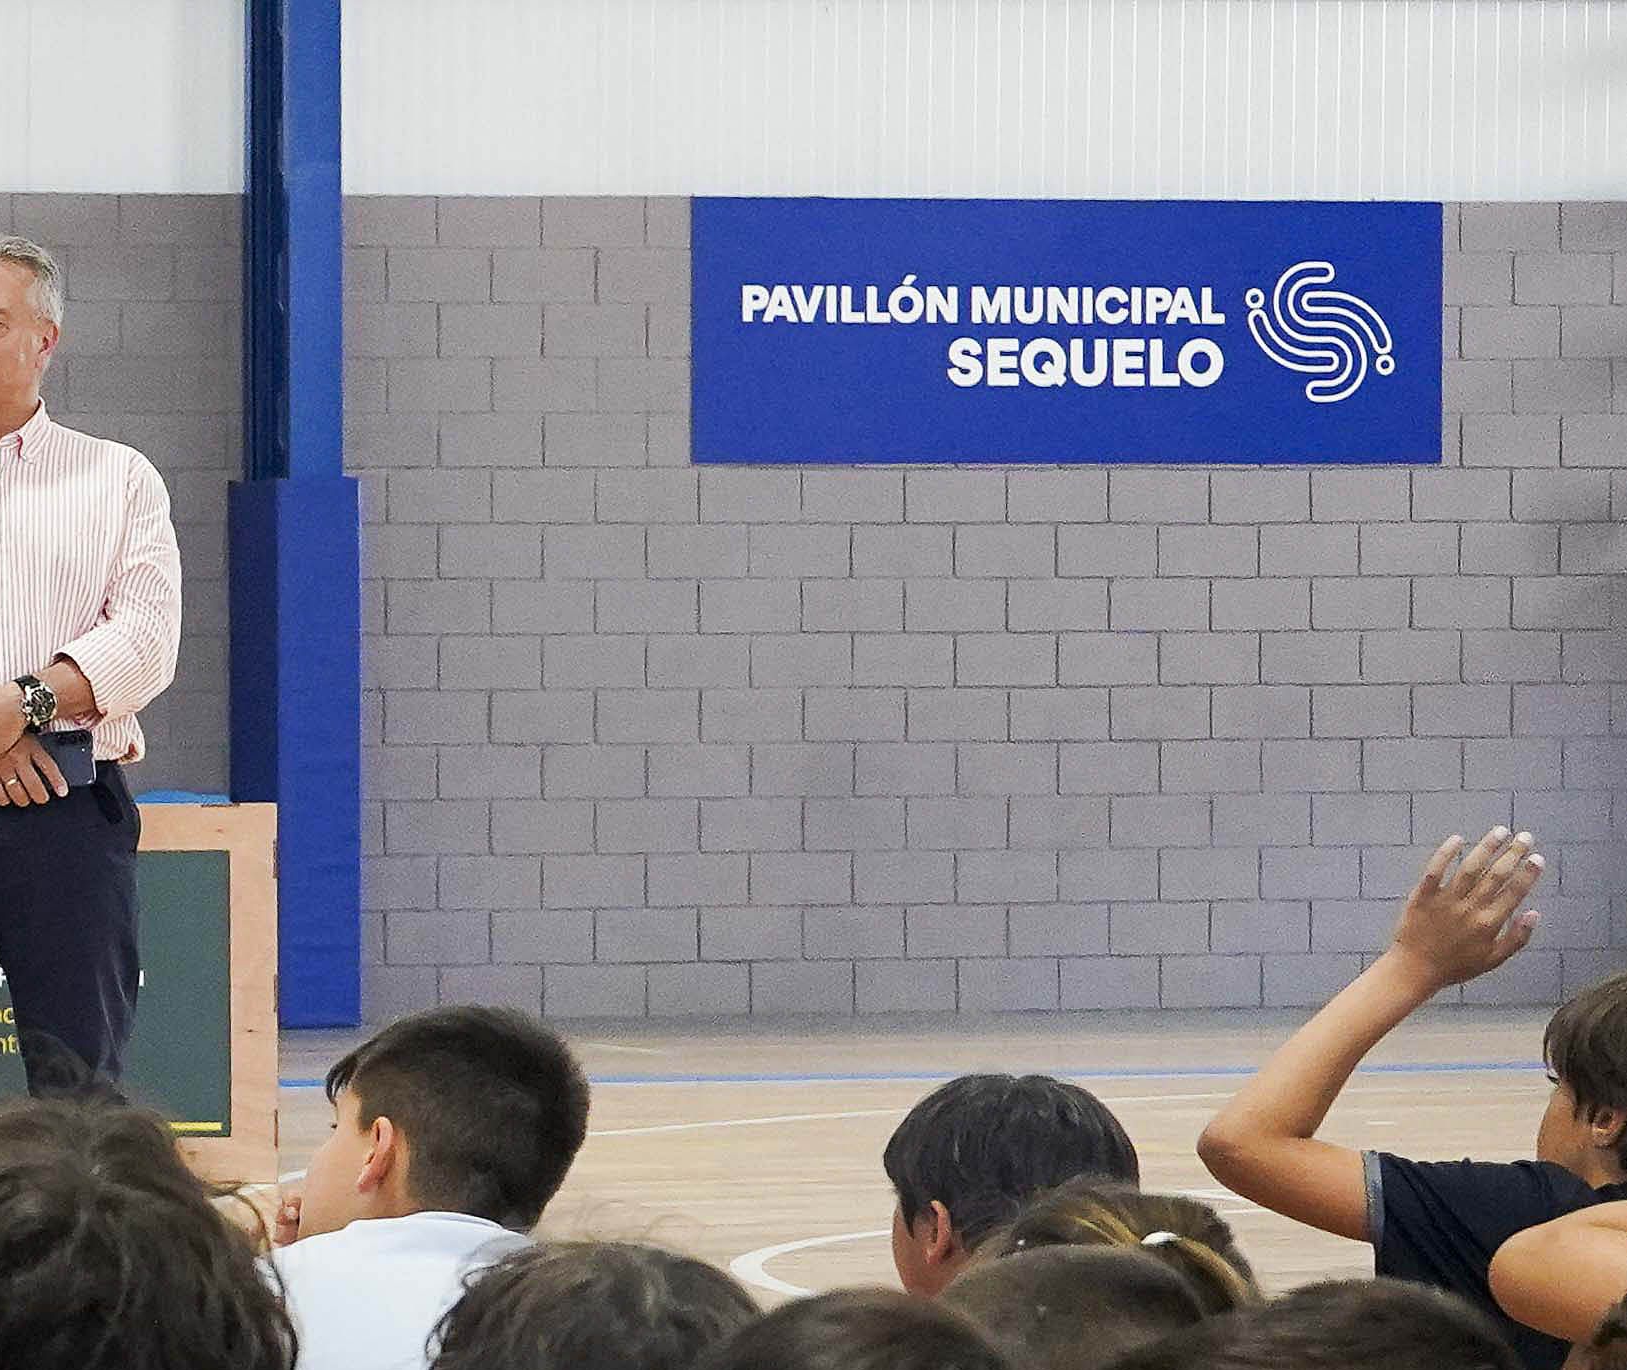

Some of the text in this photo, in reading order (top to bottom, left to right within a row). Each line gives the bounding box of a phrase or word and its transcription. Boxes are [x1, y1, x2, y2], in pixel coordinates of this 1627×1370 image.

[742, 275, 1225, 325] PAVILLÓN MUNICIPAL
[947, 338, 1225, 387] SEQUELO
